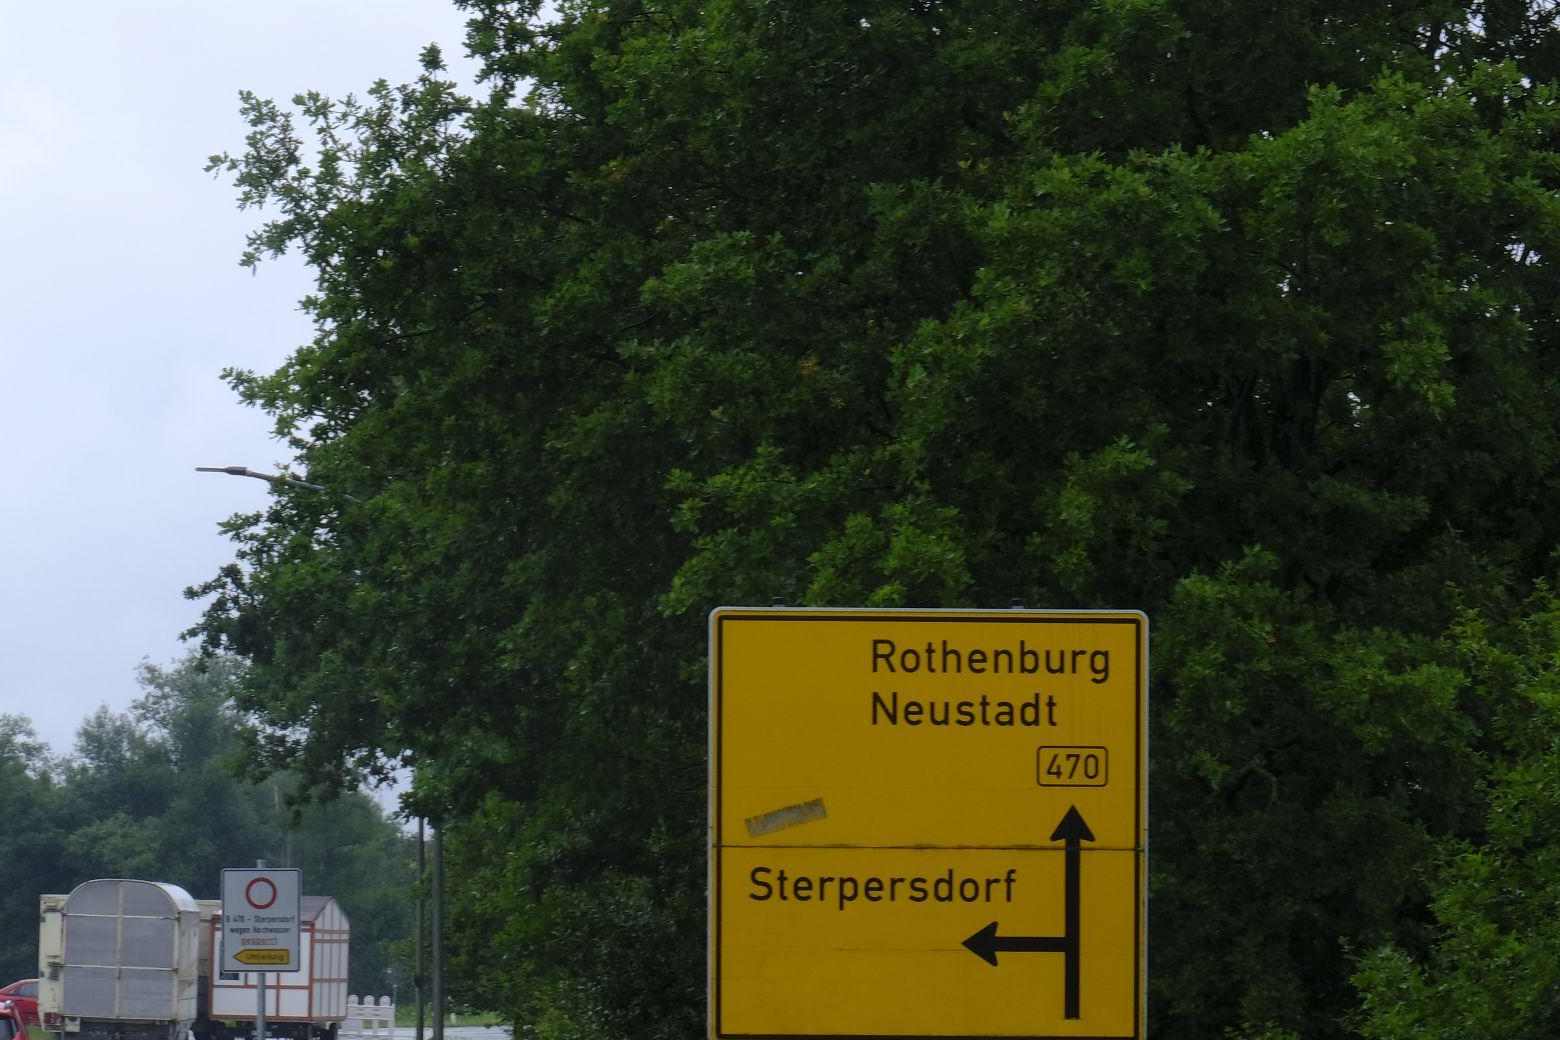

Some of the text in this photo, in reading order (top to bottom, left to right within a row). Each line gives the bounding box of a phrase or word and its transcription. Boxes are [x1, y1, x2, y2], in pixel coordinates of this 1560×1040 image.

[871, 639, 1111, 684] Rothenburg
[871, 692, 1058, 726] Neustadt
[1046, 753, 1100, 780] 470
[748, 867, 1017, 911] Sterpersdorf
